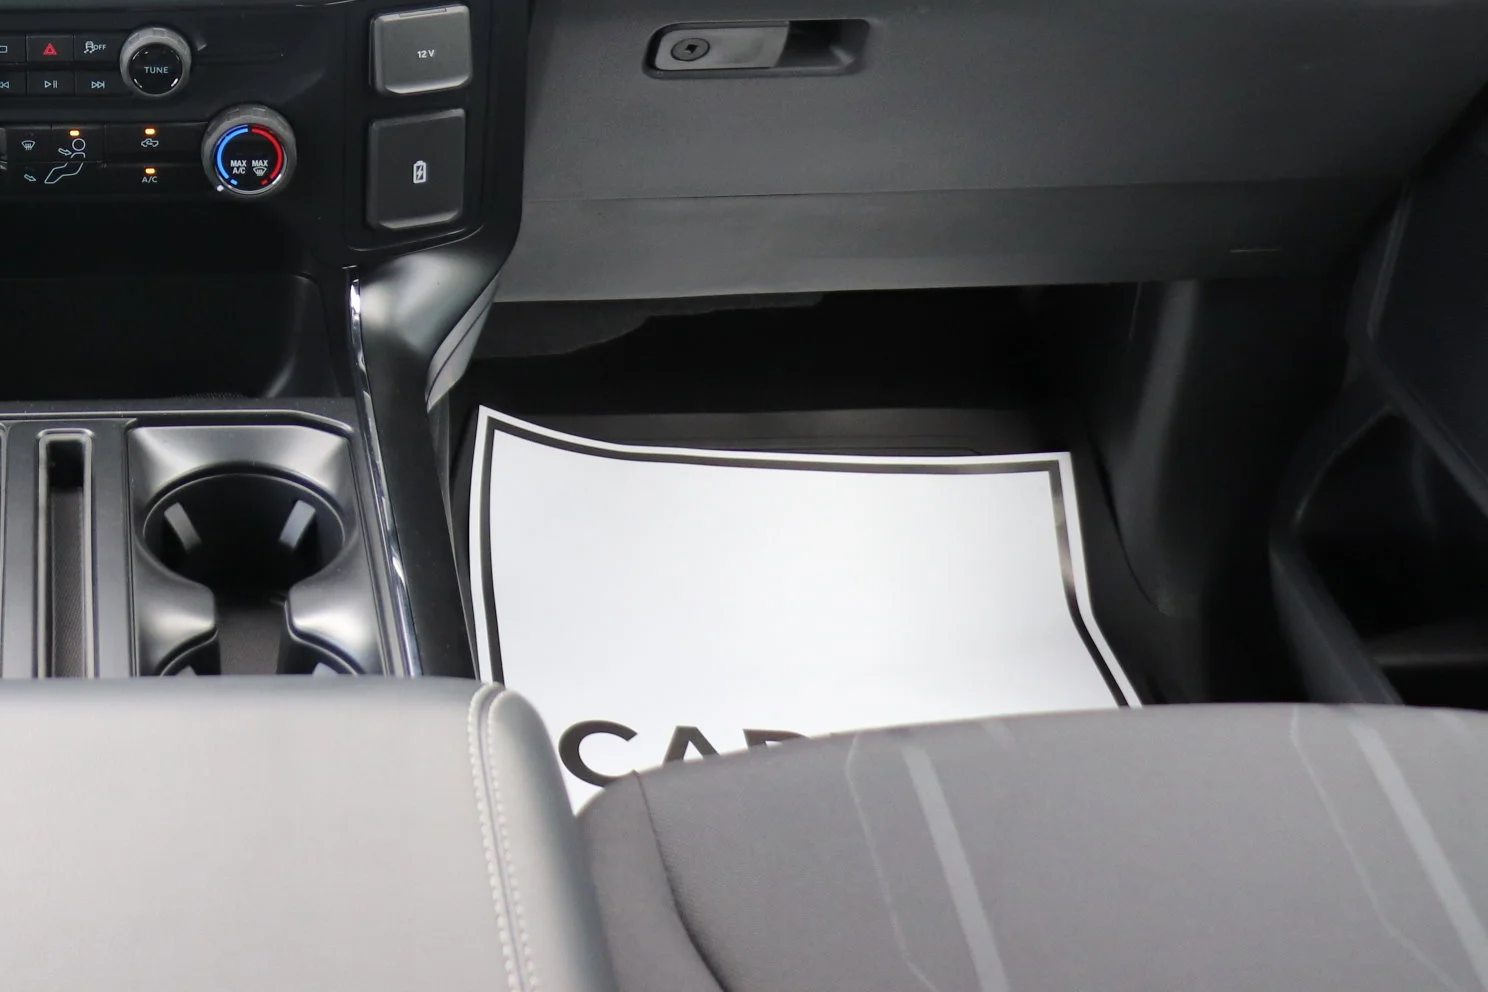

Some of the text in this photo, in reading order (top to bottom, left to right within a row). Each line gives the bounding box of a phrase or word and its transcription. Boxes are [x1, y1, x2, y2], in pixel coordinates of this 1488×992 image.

[93, 43, 107, 51] OFF
[144, 66, 169, 74] TUNE
[230, 159, 268, 167] MAX MAX
[232, 167, 246, 175] A/C
[141, 175, 158, 184] A/C
